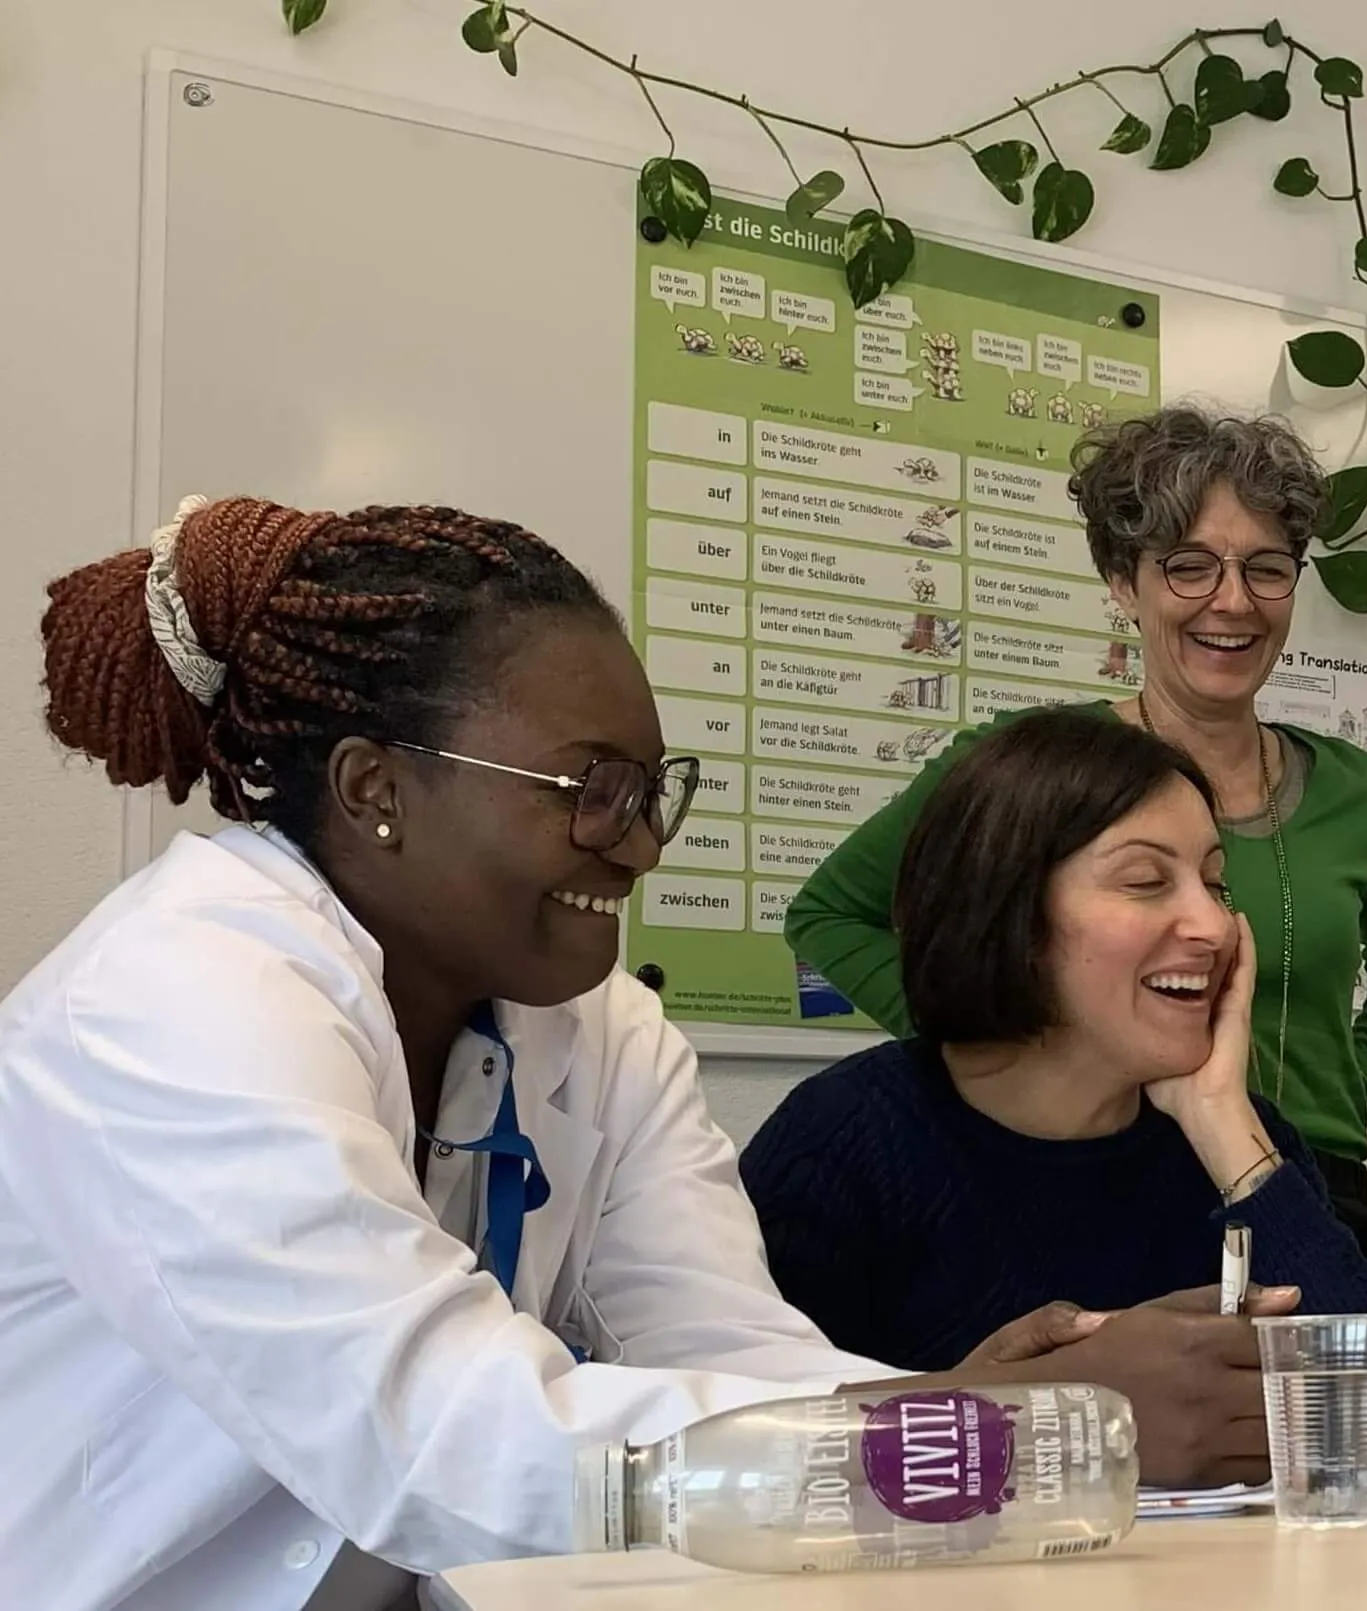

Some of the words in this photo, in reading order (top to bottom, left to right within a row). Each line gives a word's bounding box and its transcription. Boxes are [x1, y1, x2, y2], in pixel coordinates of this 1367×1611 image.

[703, 212, 723, 232] st
[730, 216, 763, 239] die
[658, 272, 672, 283] Ich
[673, 273, 688, 286] bin
[720, 273, 734, 284] Ich
[735, 275, 749, 287] bin
[658, 285, 673, 294] vor
[720, 286, 761, 301] zwischen
[779, 296, 793, 307] Ich
[793, 298, 807, 310] bin
[778, 307, 805, 320] hinter
[863, 305, 883, 318] über
[861, 331, 875, 342] Ich
[876, 333, 890, 344] bin
[861, 378, 875, 389] Ich
[876, 380, 890, 392] bin
[861, 390, 885, 402] unter
[718, 428, 731, 443] in
[761, 431, 778, 443] Die
[780, 434, 838, 453] Schildkröte
[839, 445, 862, 458] geht
[761, 447, 777, 460] ins
[974, 467, 989, 479] Die
[991, 471, 1042, 489] Schildkröte
[707, 487, 732, 502] auf
[974, 484, 985, 496] ist
[987, 486, 999, 498] im
[761, 488, 800, 504] Jemand
[802, 494, 828, 508] setzt
[830, 497, 846, 510] die
[848, 500, 904, 519] Schildkröte
[761, 505, 779, 518] auf
[782, 507, 811, 521] einen
[974, 522, 989, 535] Die
[991, 525, 1043, 543] Schildkröte
[1044, 534, 1056, 546] ist
[697, 541, 731, 558] über
[974, 538, 990, 551] auf
[992, 542, 1021, 555] einem
[761, 545, 778, 557] Ein
[779, 548, 808, 563] Vogel
[810, 552, 836, 567] fliegt
[761, 561, 785, 576] über
[788, 564, 804, 577] die
[1000, 579, 1016, 593] der
[1018, 583, 1071, 601] Schildkröte
[975, 592, 995, 605] sitzt
[997, 596, 1012, 607] ein
[690, 600, 730, 616] unter
[760, 603, 798, 618] Jemand
[801, 608, 826, 621] setzt
[828, 610, 845, 624] die
[847, 613, 902, 632] Schildkröte
[760, 619, 789, 633] unter
[792, 622, 821, 636] einen
[974, 631, 989, 644] Die
[991, 635, 1042, 652] Schildkröte
[1044, 642, 1064, 655] sitzt
[974, 648, 999, 661] unter
[1001, 651, 1030, 665] einem
[712, 661, 730, 674] an
[760, 660, 777, 672] Die
[780, 662, 837, 680] Schildkröte
[839, 669, 862, 683] geht
[760, 677, 774, 688] an
[776, 677, 793, 690] die
[973, 687, 988, 699] Die
[990, 689, 1042, 705] Schildkröte
[972, 705, 985, 714] an
[706, 719, 730, 732] vor
[760, 718, 798, 733] Jemand
[801, 722, 820, 737] legt
[823, 725, 848, 738] Salat
[760, 736, 778, 748] vor
[780, 736, 797, 749] die
[698, 777, 729, 792] nter
[759, 776, 776, 788] Die
[779, 778, 835, 795] Schildkröte
[838, 783, 860, 797] geht
[758, 793, 790, 807] hinter
[793, 797, 821, 809] einen
[823, 799, 853, 813] Stein.
[685, 833, 730, 849] neben
[759, 834, 777, 846] Die
[779, 835, 836, 851] Schildkröte
[759, 852, 782, 864] eine
[784, 852, 821, 866] andere
[660, 891, 730, 909] zwischen
[760, 892, 777, 905] Die
[900, 1398, 960, 1505] VIVITZ
[1033, 1436, 1062, 1504] CLASSIC
[966, 1471, 981, 1496] MEIN
[805, 1475, 850, 1527] BIO
